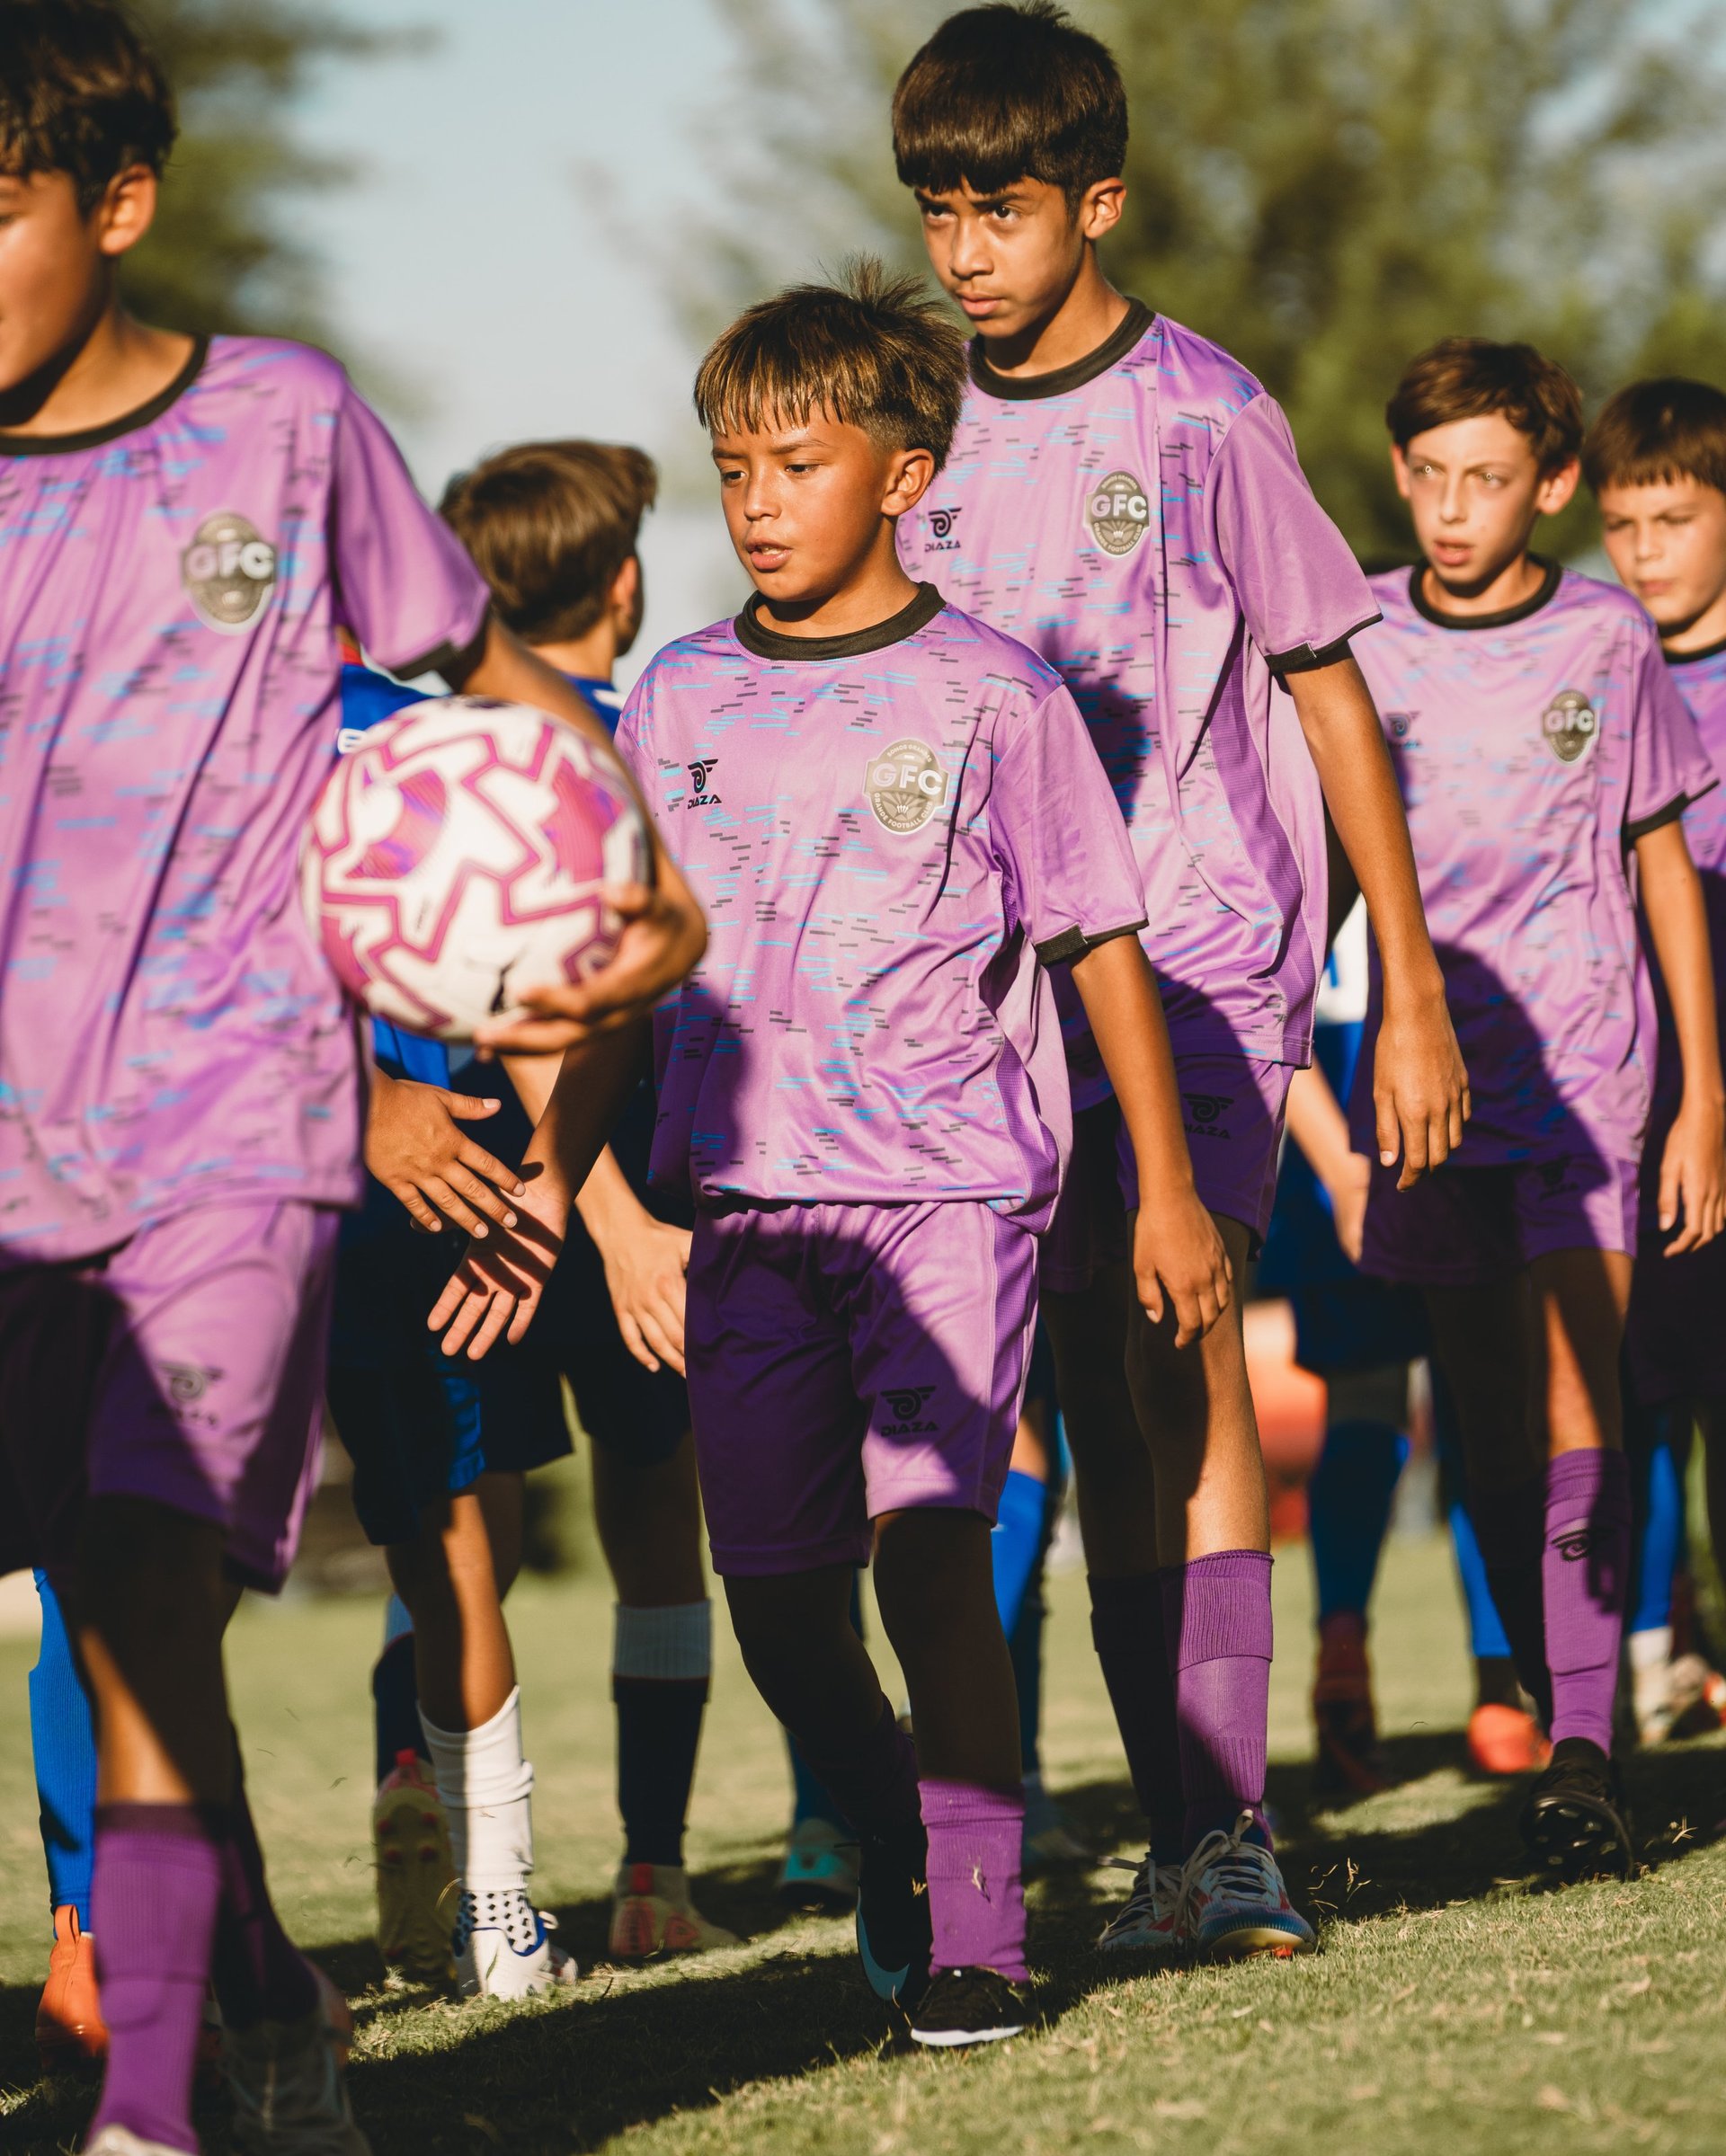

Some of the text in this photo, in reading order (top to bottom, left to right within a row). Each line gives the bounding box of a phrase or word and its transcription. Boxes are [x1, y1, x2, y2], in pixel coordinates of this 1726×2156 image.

[1091, 494, 1147, 519] GFC
[924, 539, 961, 553] DIAZA
[185, 540, 274, 581] GFC
[1545, 707, 1594, 733] GFC
[872, 762, 943, 795] GFC
[687, 794, 722, 809] DIAZA
[874, 792, 888, 821] GRANDE
[887, 817, 922, 829] FOOTBALL
[881, 1422, 939, 1437] DIAZA
